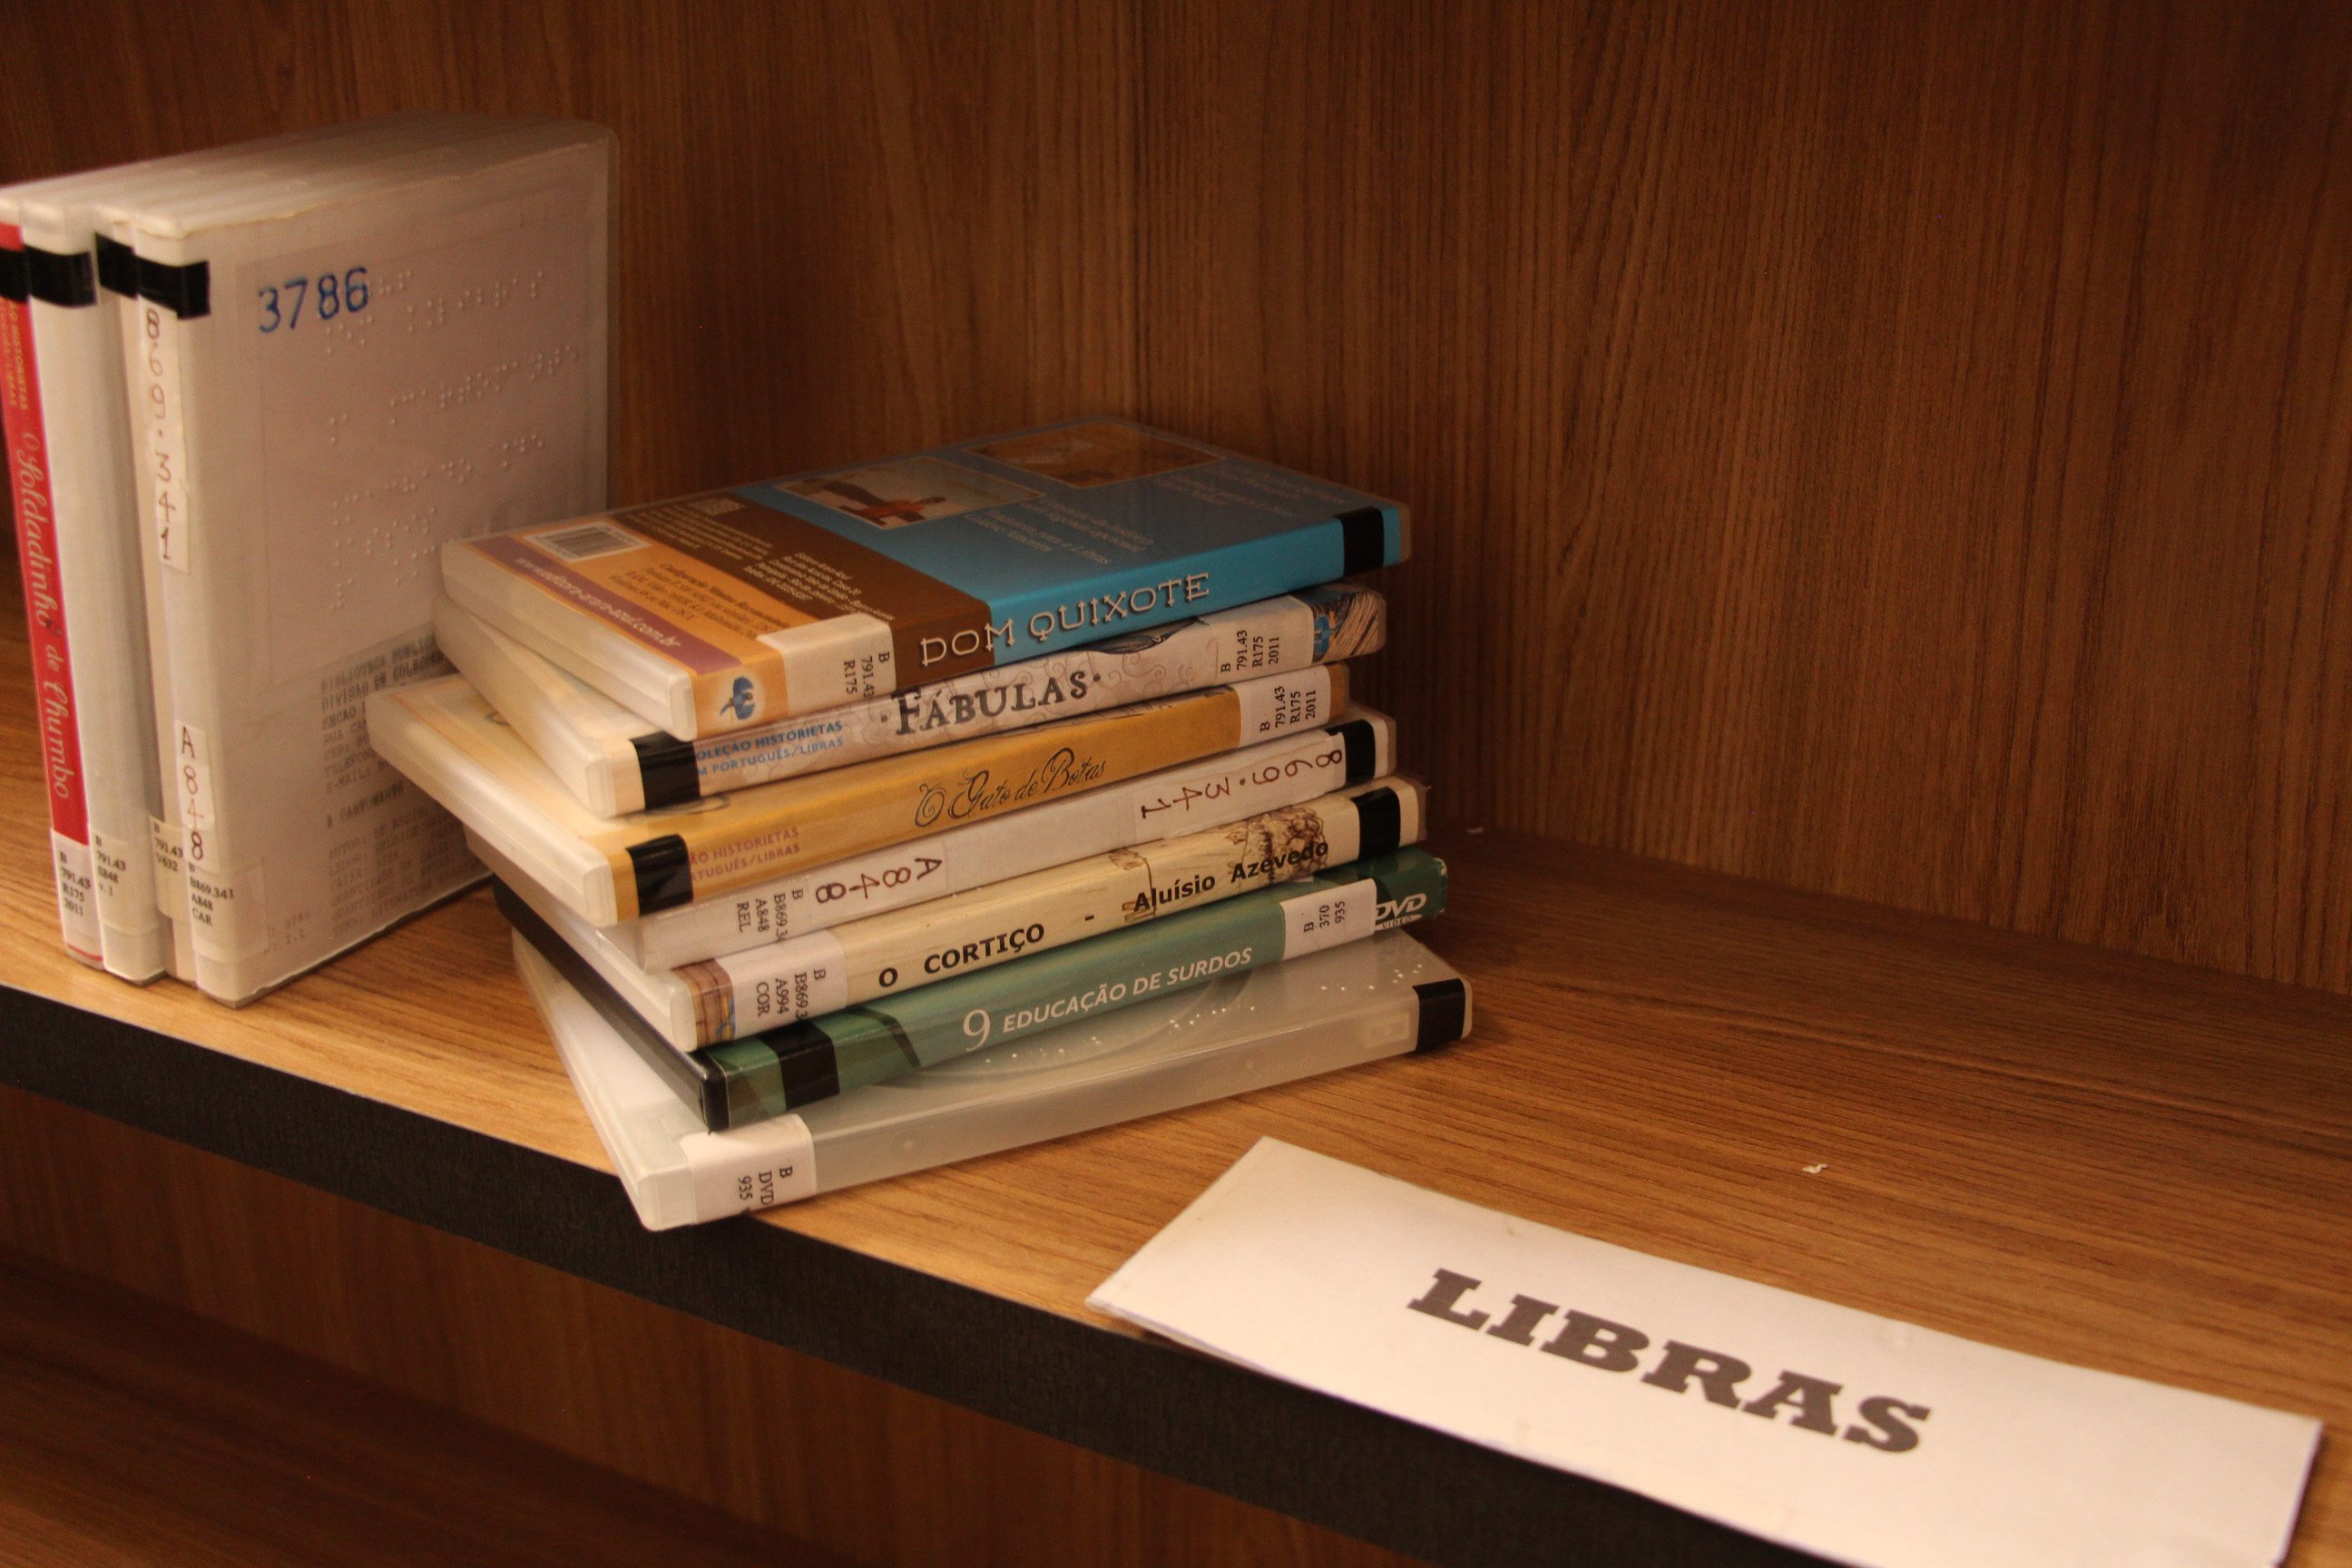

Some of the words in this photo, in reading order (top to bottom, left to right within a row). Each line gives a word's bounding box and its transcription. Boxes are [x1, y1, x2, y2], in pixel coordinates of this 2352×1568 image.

[258, 265, 368, 332] 3786
[920, 618, 1015, 667] DOM
[1029, 573, 1210, 642] QUIXOTE
[45, 644, 64, 672] de
[877, 652, 890, 663] B
[1237, 630, 1248, 671] 791.43
[1252, 635, 1264, 668] R175
[1268, 636, 1279, 665] 2011
[844, 659, 858, 694] R175
[861, 655, 875, 699] 791.43
[1220, 662, 1231, 673] B
[892, 671, 1088, 735] FÁBULAS
[1275, 686, 1285, 728] 791.43
[1290, 691, 1301, 724] R175
[1306, 690, 1316, 720] 2011
[43, 679, 75, 799] Chumbo
[695, 740, 752, 761] OLEÇÃO
[755, 720, 843, 749] HISTORIETAS
[1259, 721, 1270, 732] B
[712, 737, 844, 773] PORTUGUÊS/LIBRAS
[915, 783, 946, 827] O
[947, 768, 1011, 819] Gato
[1014, 769, 1038, 801] de
[1042, 747, 1107, 793] Botas
[1141, 750, 1343, 818] 869.341
[60, 851, 67, 864] B
[712, 826, 799, 859] HISTORIETAS
[96, 849, 126, 871] 791.43
[691, 842, 800, 881] TUGUÊS/LIBRAS
[60, 866, 91, 889] 791.43
[792, 887, 804, 900] B
[815, 858, 943, 904] A848
[737, 901, 751, 932] REL
[755, 898, 769, 932] A848
[878, 967, 899, 988] O
[924, 922, 1045, 975] CORTIÇO
[1132, 872, 1217, 914] Aluísio
[1230, 840, 1330, 884] Azevedo
[1319, 905, 1330, 928] 370
[1335, 901, 1346, 924] 935
[1376, 893, 1427, 921] DVD
[1303, 922, 1314, 932] B
[813, 967, 826, 980] B
[756, 982, 770, 1017] COR
[775, 977, 789, 1014] A994
[963, 1009, 991, 1052] 9
[1002, 982, 1126, 1034] EDUCAÇÃO
[1132, 972, 1162, 995] DE
[1166, 946, 1253, 986] SURDOS
[738, 1175, 753, 1200] 935
[759, 1170, 774, 1205] DVD
[779, 1165, 793, 1178] B
[1406, 1267, 1933, 1454] LIBRAS
